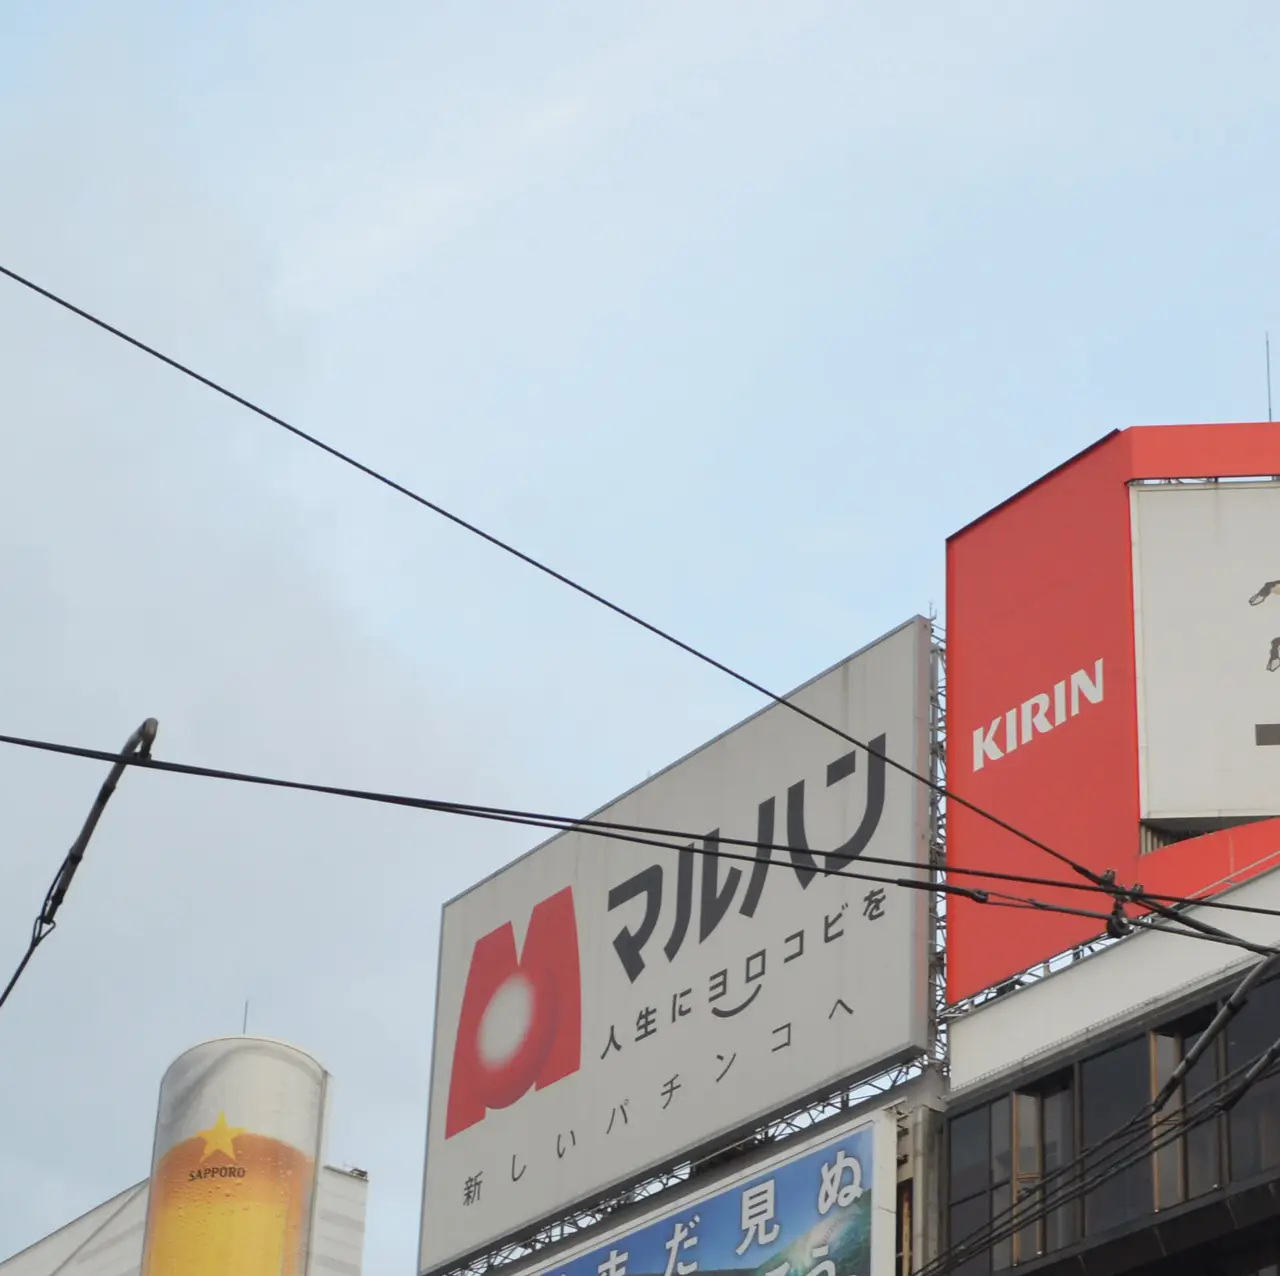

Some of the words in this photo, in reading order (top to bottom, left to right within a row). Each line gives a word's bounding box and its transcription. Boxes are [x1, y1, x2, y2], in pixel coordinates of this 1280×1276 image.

[972, 657, 1105, 773] KIRIN
[607, 731, 887, 984] マルハン
[600, 888, 887, 1060] 人生にヨロコビを
[188, 1165, 246, 1182] SAPPORO
[462, 998, 855, 1208] 新しいパチンコへ
